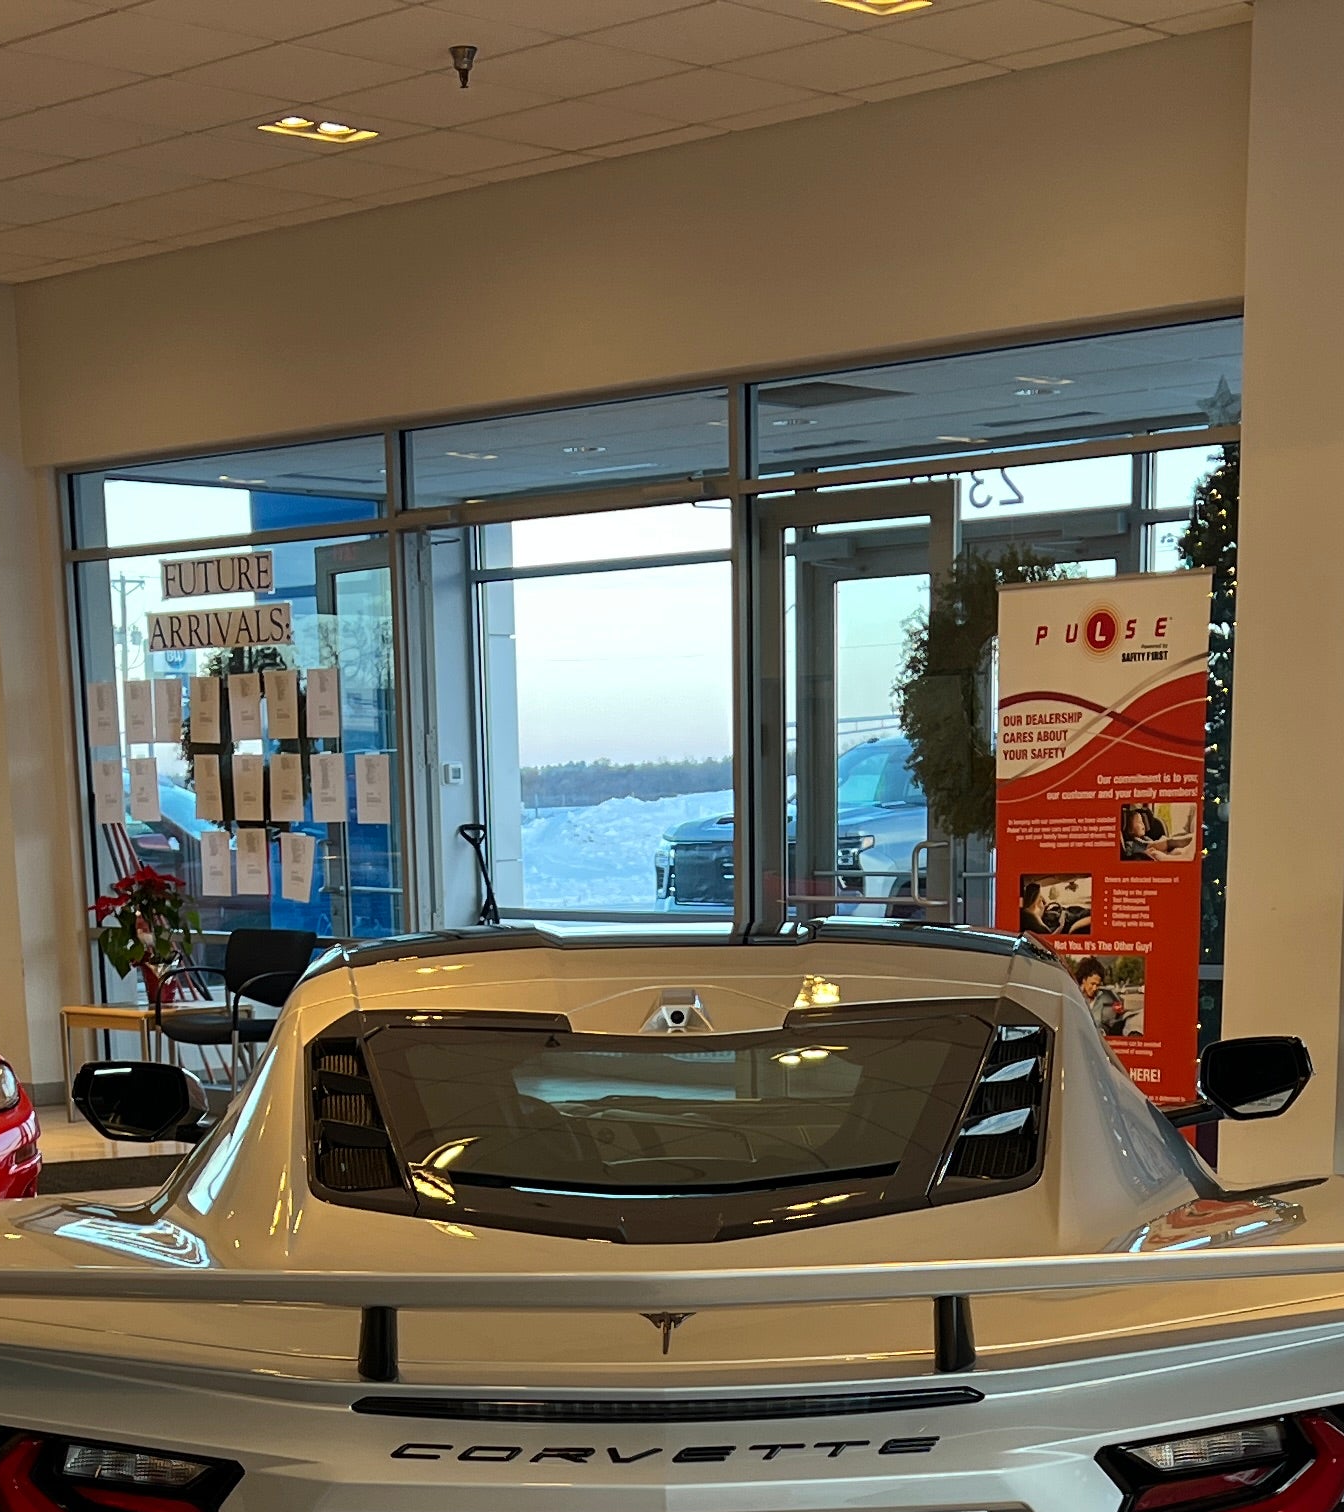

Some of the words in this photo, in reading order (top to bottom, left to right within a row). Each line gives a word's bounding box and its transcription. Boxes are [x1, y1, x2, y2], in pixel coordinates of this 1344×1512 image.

[163, 555, 271, 597] FUTURE
[150, 607, 291, 650] ARRIVALS:
[1036, 617, 1167, 645] PULSE
[1003, 715, 1022, 727] OUR
[1026, 712, 1082, 725] DEALERSHIP
[1003, 732, 1033, 744] CARES
[1037, 730, 1068, 742] ABOUT
[1003, 749, 1027, 761] YOUR
[1031, 747, 1066, 760] SAFETY
[1097, 774, 1112, 784] Our
[1163, 773, 1171, 783] is
[1173, 772, 1181, 783] to
[1098, 789, 1113, 799] and
[1115, 789, 1132, 800] your
[1097, 940, 1112, 951] The
[1113, 940, 1134, 951] Other
[1135, 941, 1152, 954] Guy!
[1129, 1067, 1161, 1082] HERE!
[390, 1436, 941, 1465] CORVETTE
